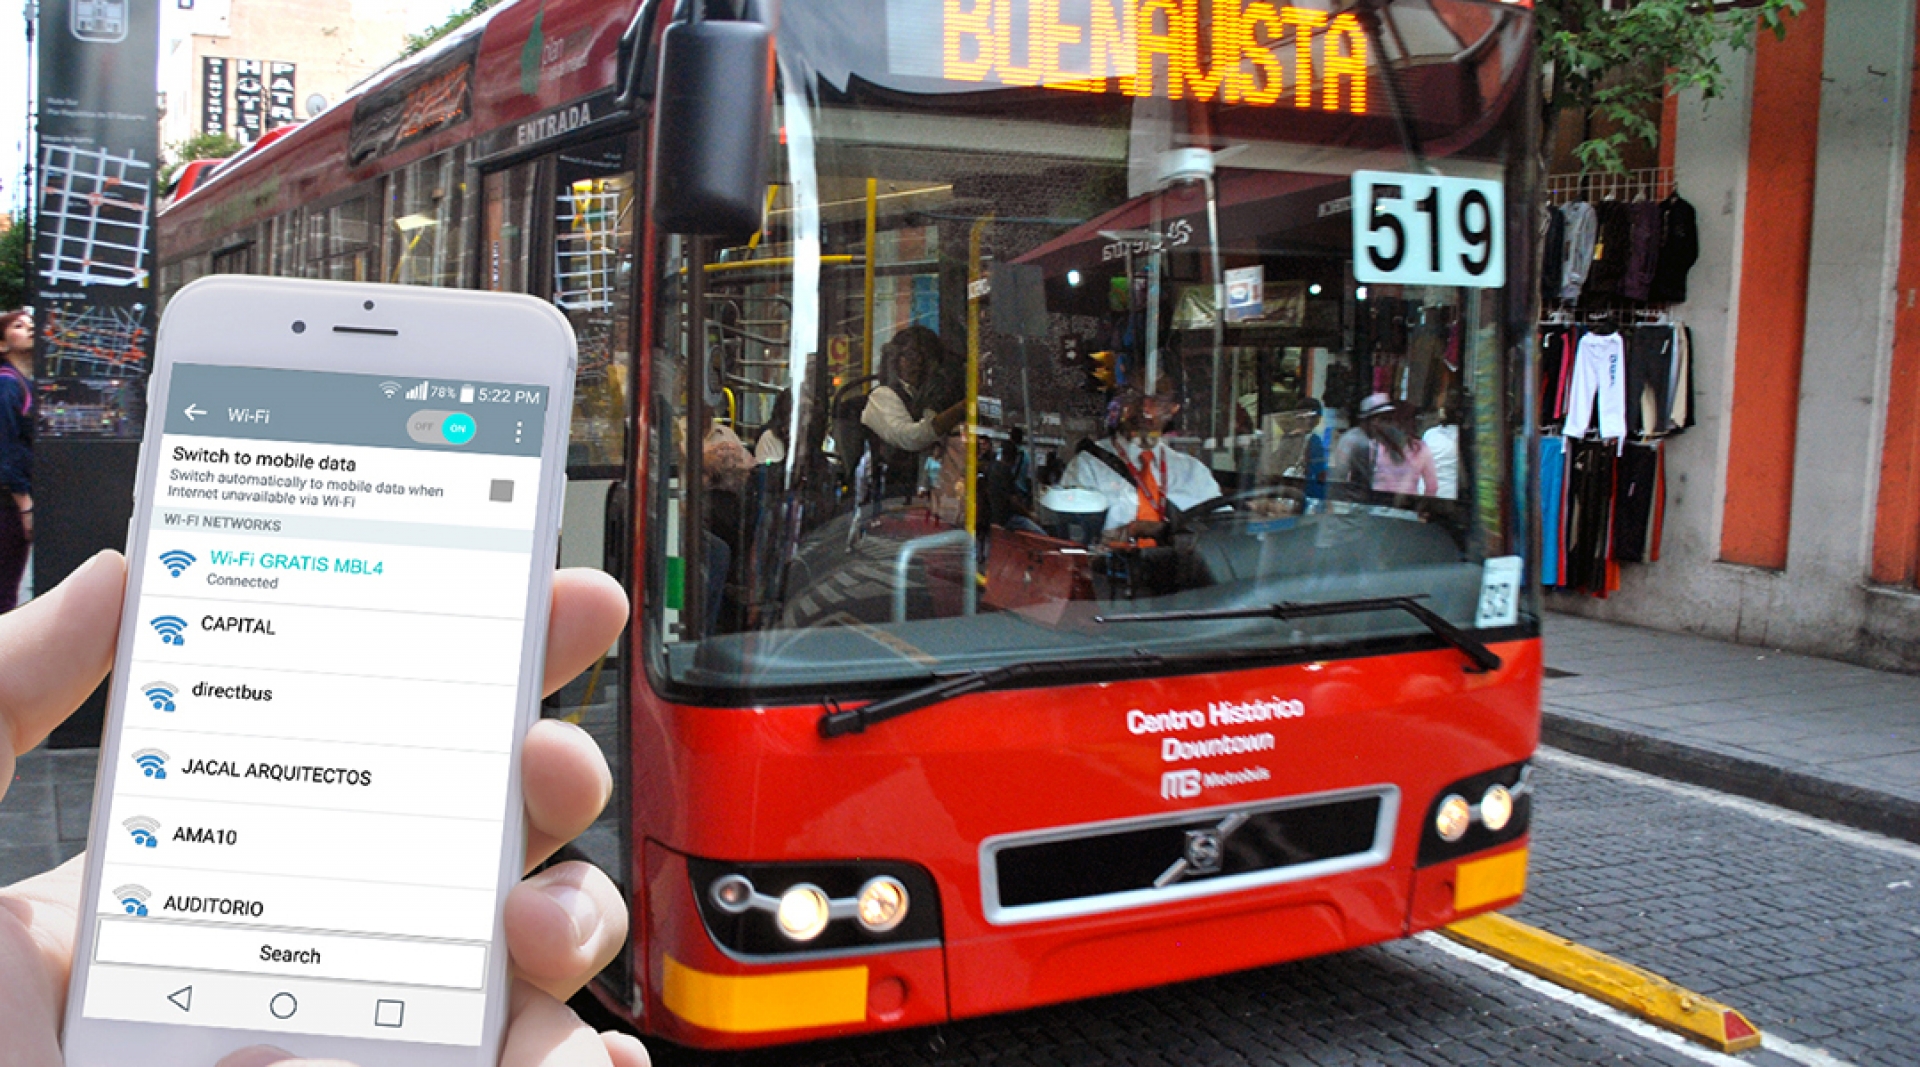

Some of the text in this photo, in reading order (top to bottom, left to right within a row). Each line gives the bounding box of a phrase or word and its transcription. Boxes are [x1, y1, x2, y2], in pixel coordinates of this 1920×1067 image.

[943, 0, 1369, 113] BUENAVISTA
[237, 60, 262, 146] HOTEL
[271, 62, 295, 126] PATR
[517, 102, 591, 145] ENTRADA
[1366, 182, 1493, 276] 519
[431, 385, 540, 404] 78% 5:22 PM
[228, 407, 270, 424] Wi-Fi
[414, 421, 434, 432] OFF
[449, 424, 467, 434] ON
[173, 446, 356, 472] Switch to mobile data
[170, 468, 444, 497] Switch automatically to mobile data when
[168, 485, 355, 508] Internet unavailable via Wi-Fi
[164, 513, 282, 532] WI-FI NETWORKS
[210, 550, 383, 575] Wi-Fi GRATIS MBL4
[206, 572, 279, 590] Connected
[200, 614, 275, 636] CAPITAL
[191, 680, 273, 702] directbus
[1127, 708, 1206, 736] Centro
[1161, 732, 1276, 762] Downtown
[181, 758, 372, 787] JACAL ARQUITECTOS
[172, 826, 237, 846] AMA10
[163, 895, 264, 917] AUDITORIO
[259, 945, 321, 964] Search
